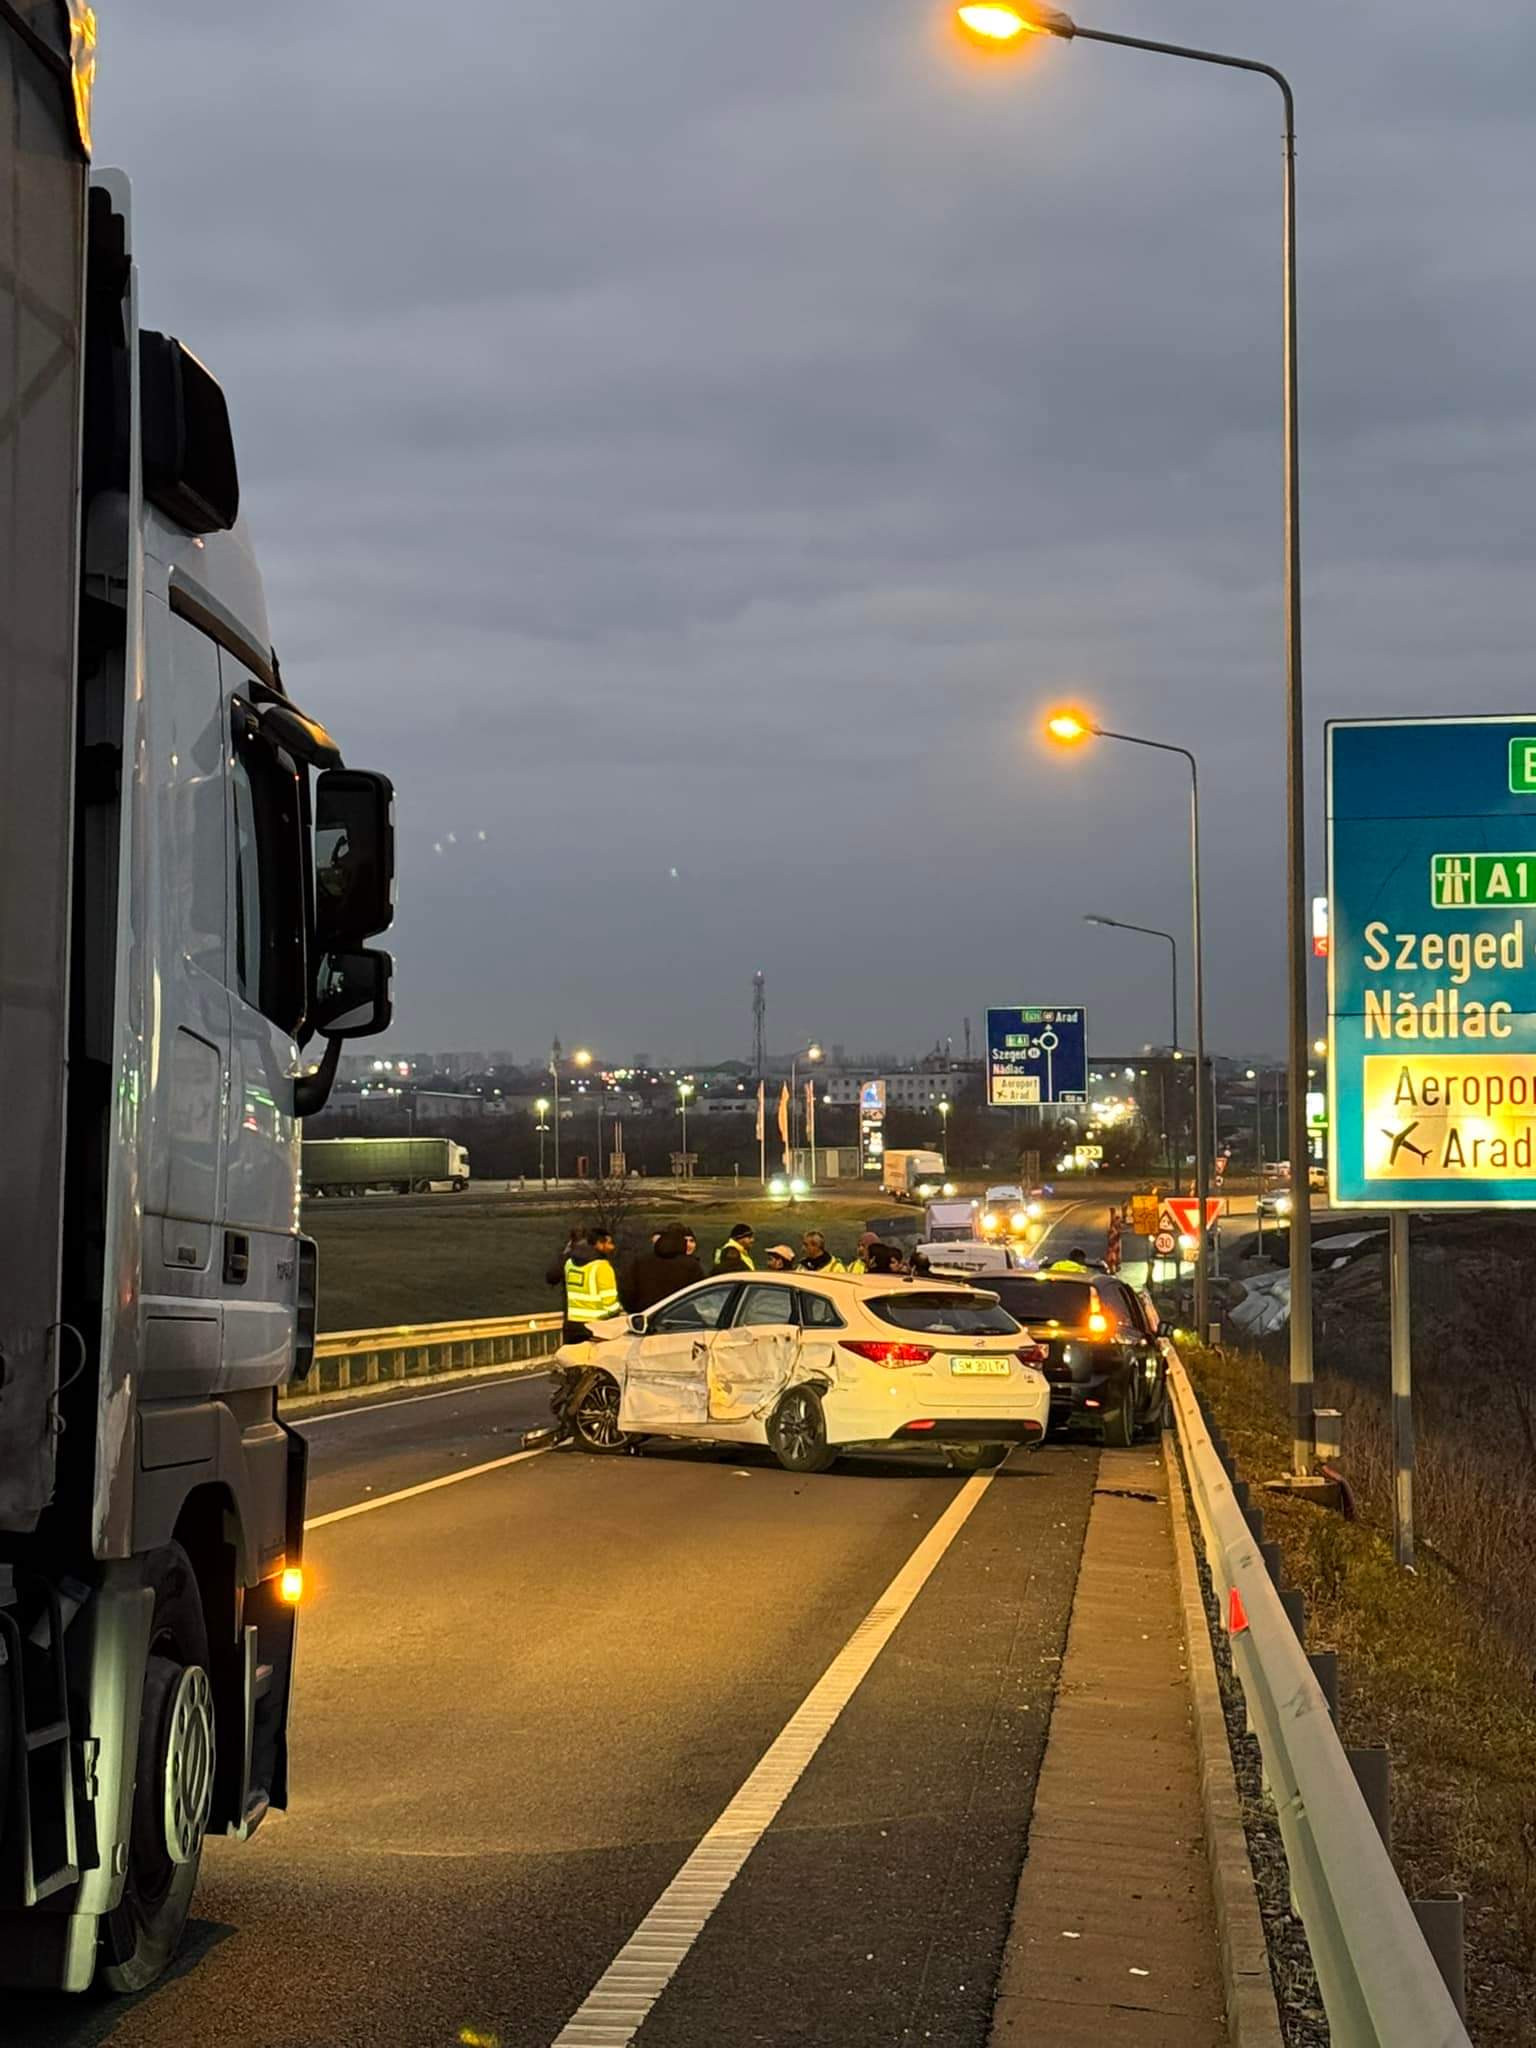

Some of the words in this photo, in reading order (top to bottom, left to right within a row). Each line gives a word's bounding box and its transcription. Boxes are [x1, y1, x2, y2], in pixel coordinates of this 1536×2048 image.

[1485, 863, 1528, 898] A1
[1363, 919, 1524, 985] Szeged
[1056, 1011, 1078, 1023] Arad
[1364, 988, 1512, 1040] Nădlac
[992, 1048, 1027, 1063] Szeged
[1394, 1065, 1536, 1117] Aeropo
[1443, 1127, 1531, 1169] Arad
[1159, 1237, 1171, 1249] 30
